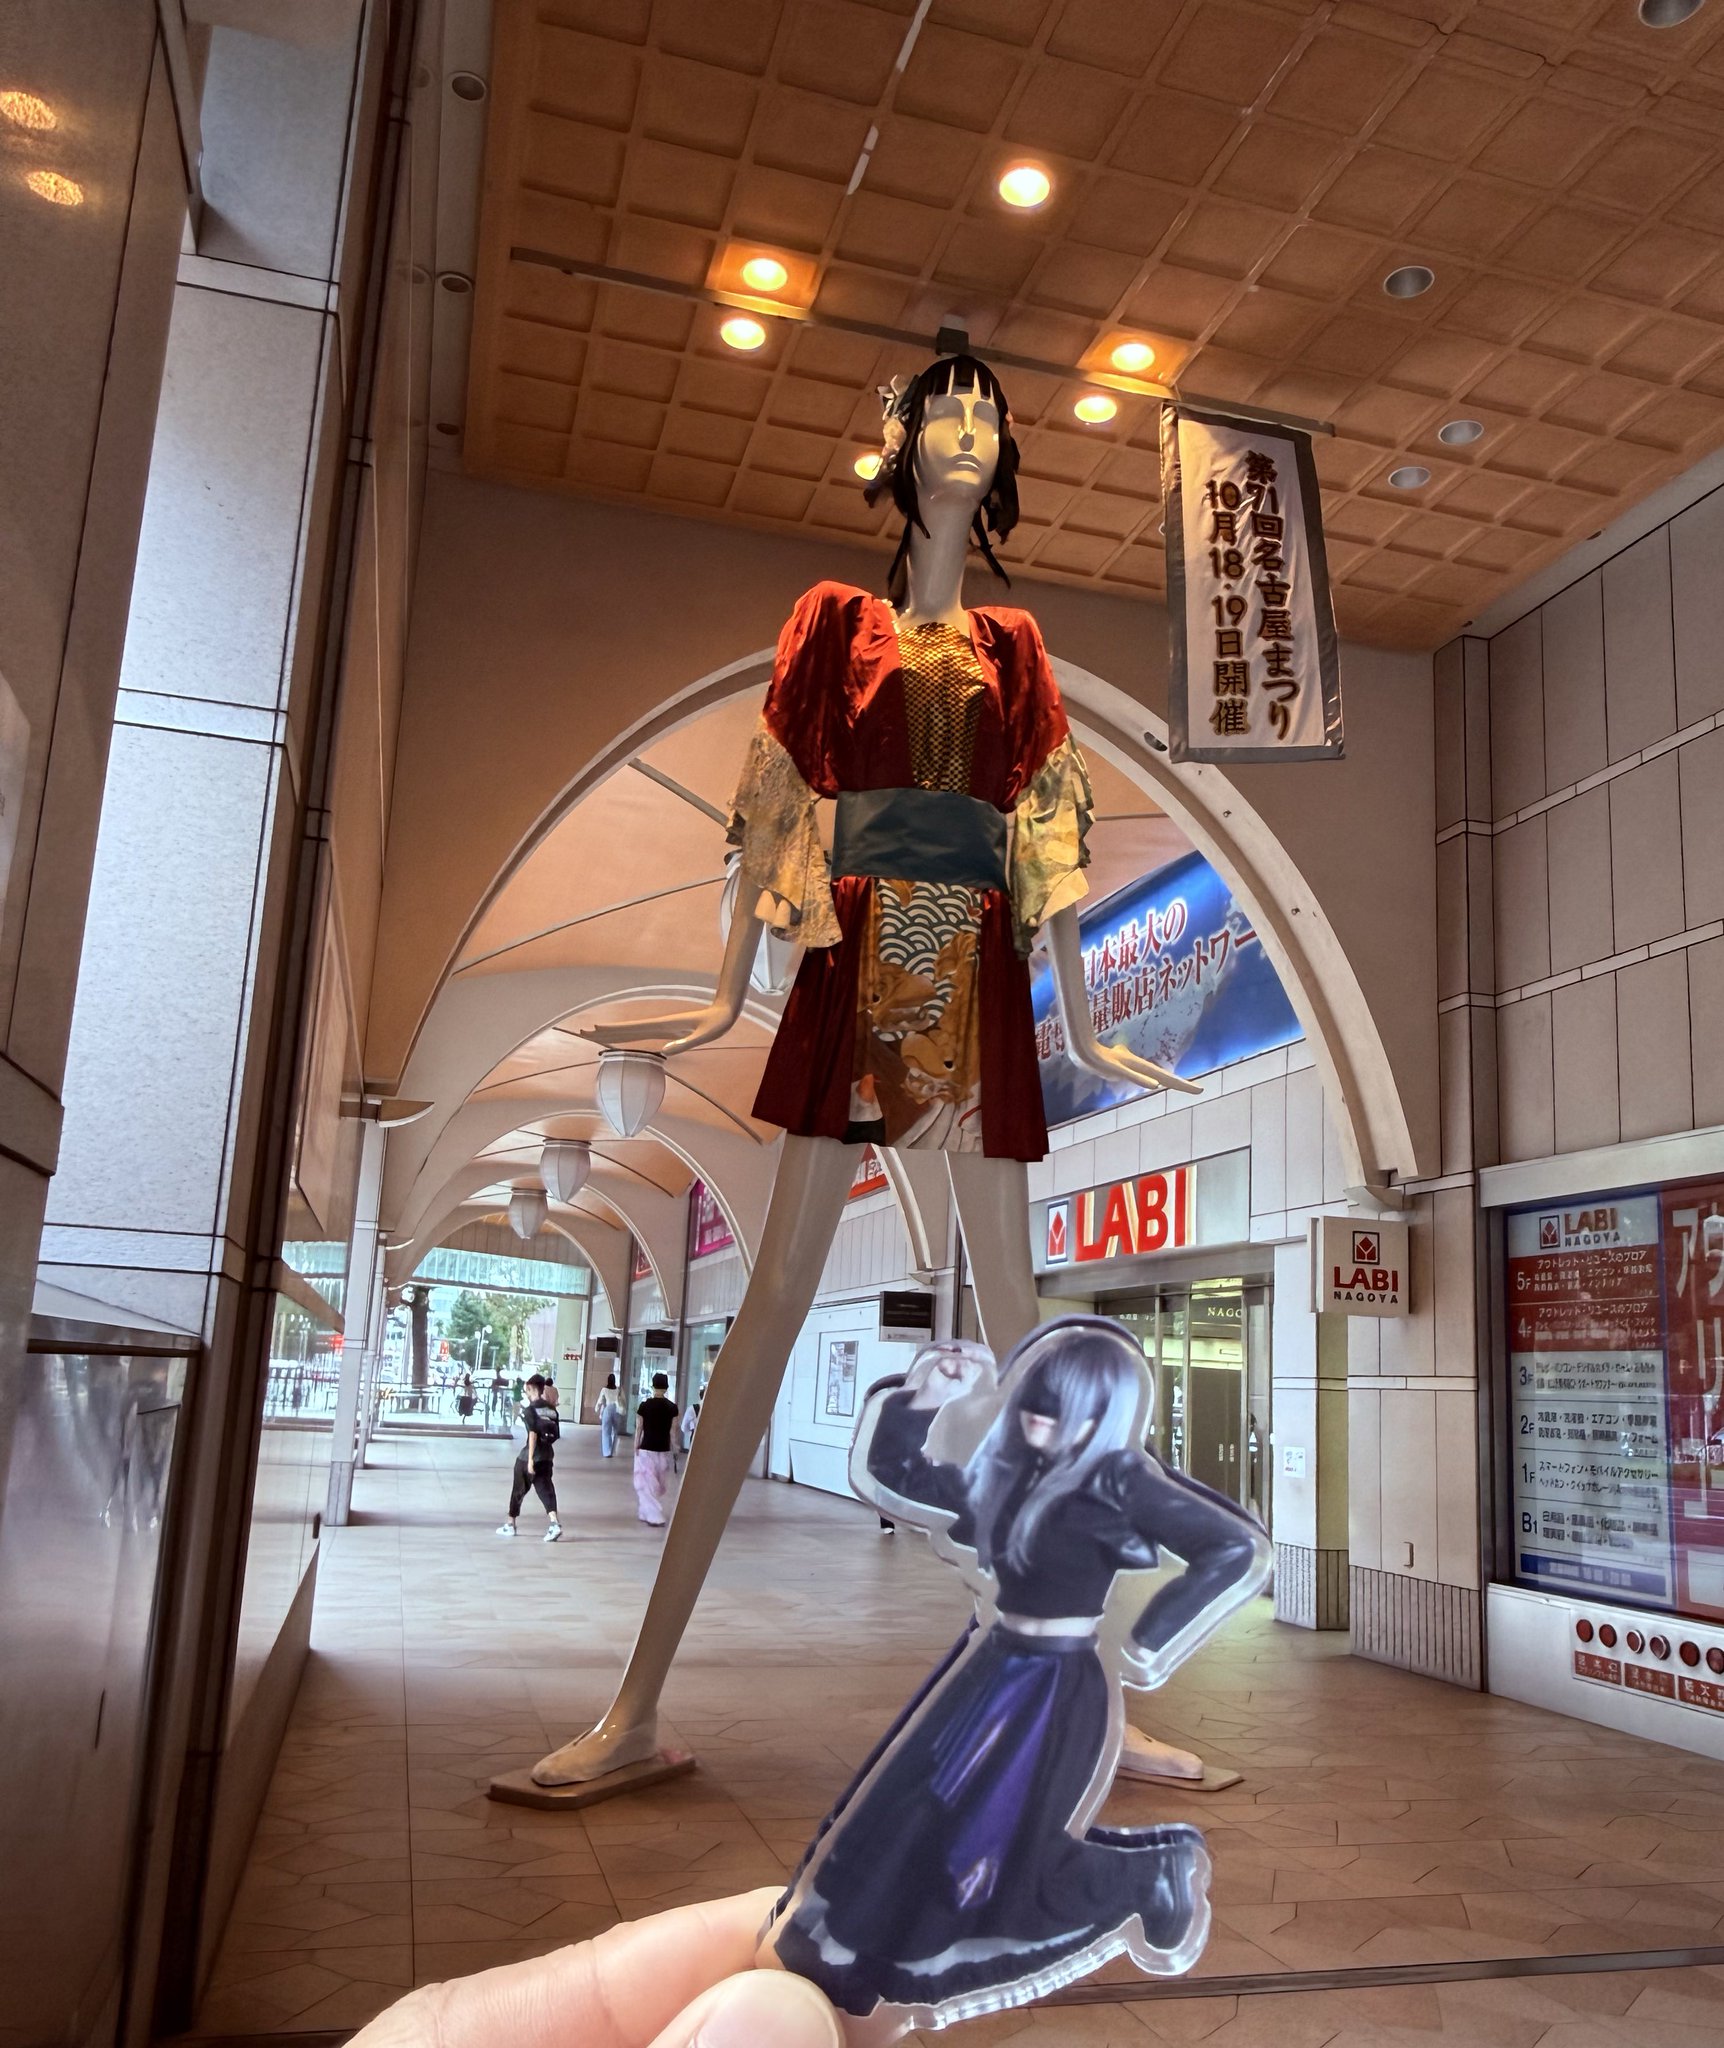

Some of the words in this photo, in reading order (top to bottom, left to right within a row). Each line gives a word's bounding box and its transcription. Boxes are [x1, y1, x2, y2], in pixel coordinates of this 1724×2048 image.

[1246, 450, 1300, 740] 第71回名古屋まつり
[1204, 480, 1250, 736] 10月18・19日開催
[1075, 1165, 1198, 1262] LABI
[1564, 1208, 1619, 1235] LABI
[1565, 1231, 1621, 1247] NAGOYA
[1333, 1266, 1399, 1292] LABI
[1517, 1271, 1531, 1290] 5F
[1333, 1291, 1399, 1304] NAGOYA
[1518, 1317, 1532, 1338] 4F
[1519, 1366, 1534, 1386] 3F
[1520, 1414, 1535, 1435] 2F
[1521, 1461, 1536, 1484] 1F
[1521, 1511, 1538, 1535] B1
